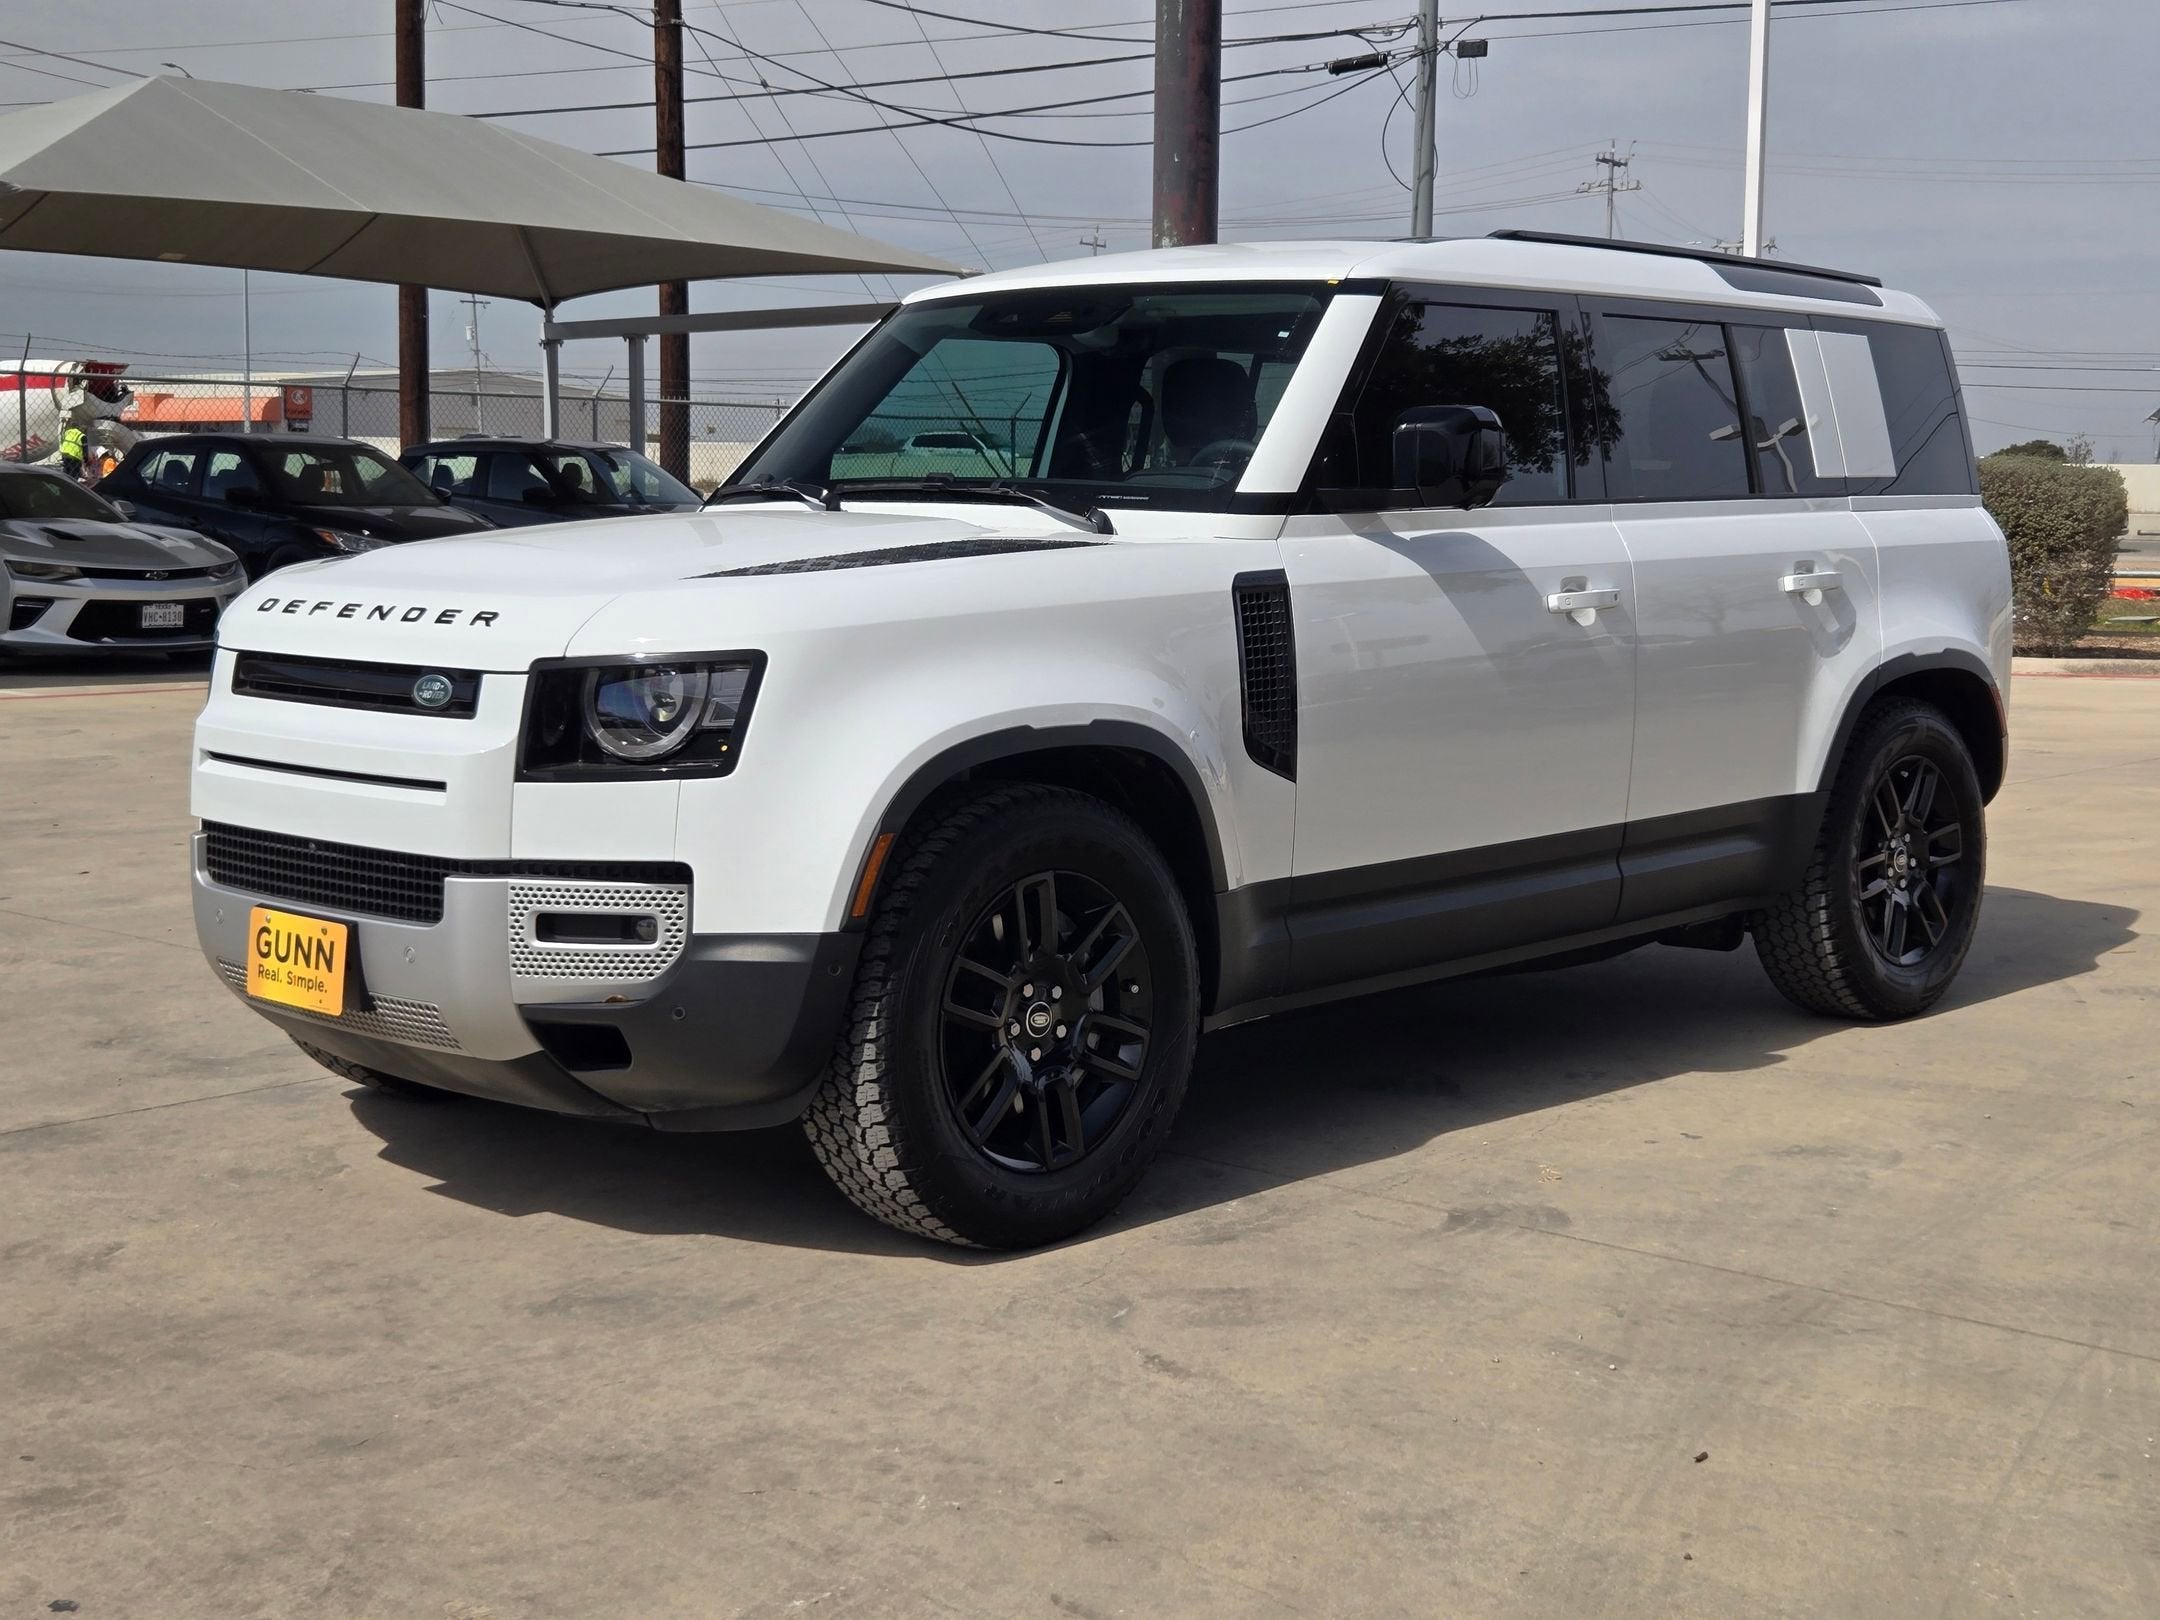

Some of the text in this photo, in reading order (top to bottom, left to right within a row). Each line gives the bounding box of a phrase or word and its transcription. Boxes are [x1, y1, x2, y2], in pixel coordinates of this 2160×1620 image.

[257, 597, 500, 628] DEFENDER
[421, 681, 441, 690] LAND
[256, 925, 335, 974] GUNN
[257, 963, 283, 984] Real.
